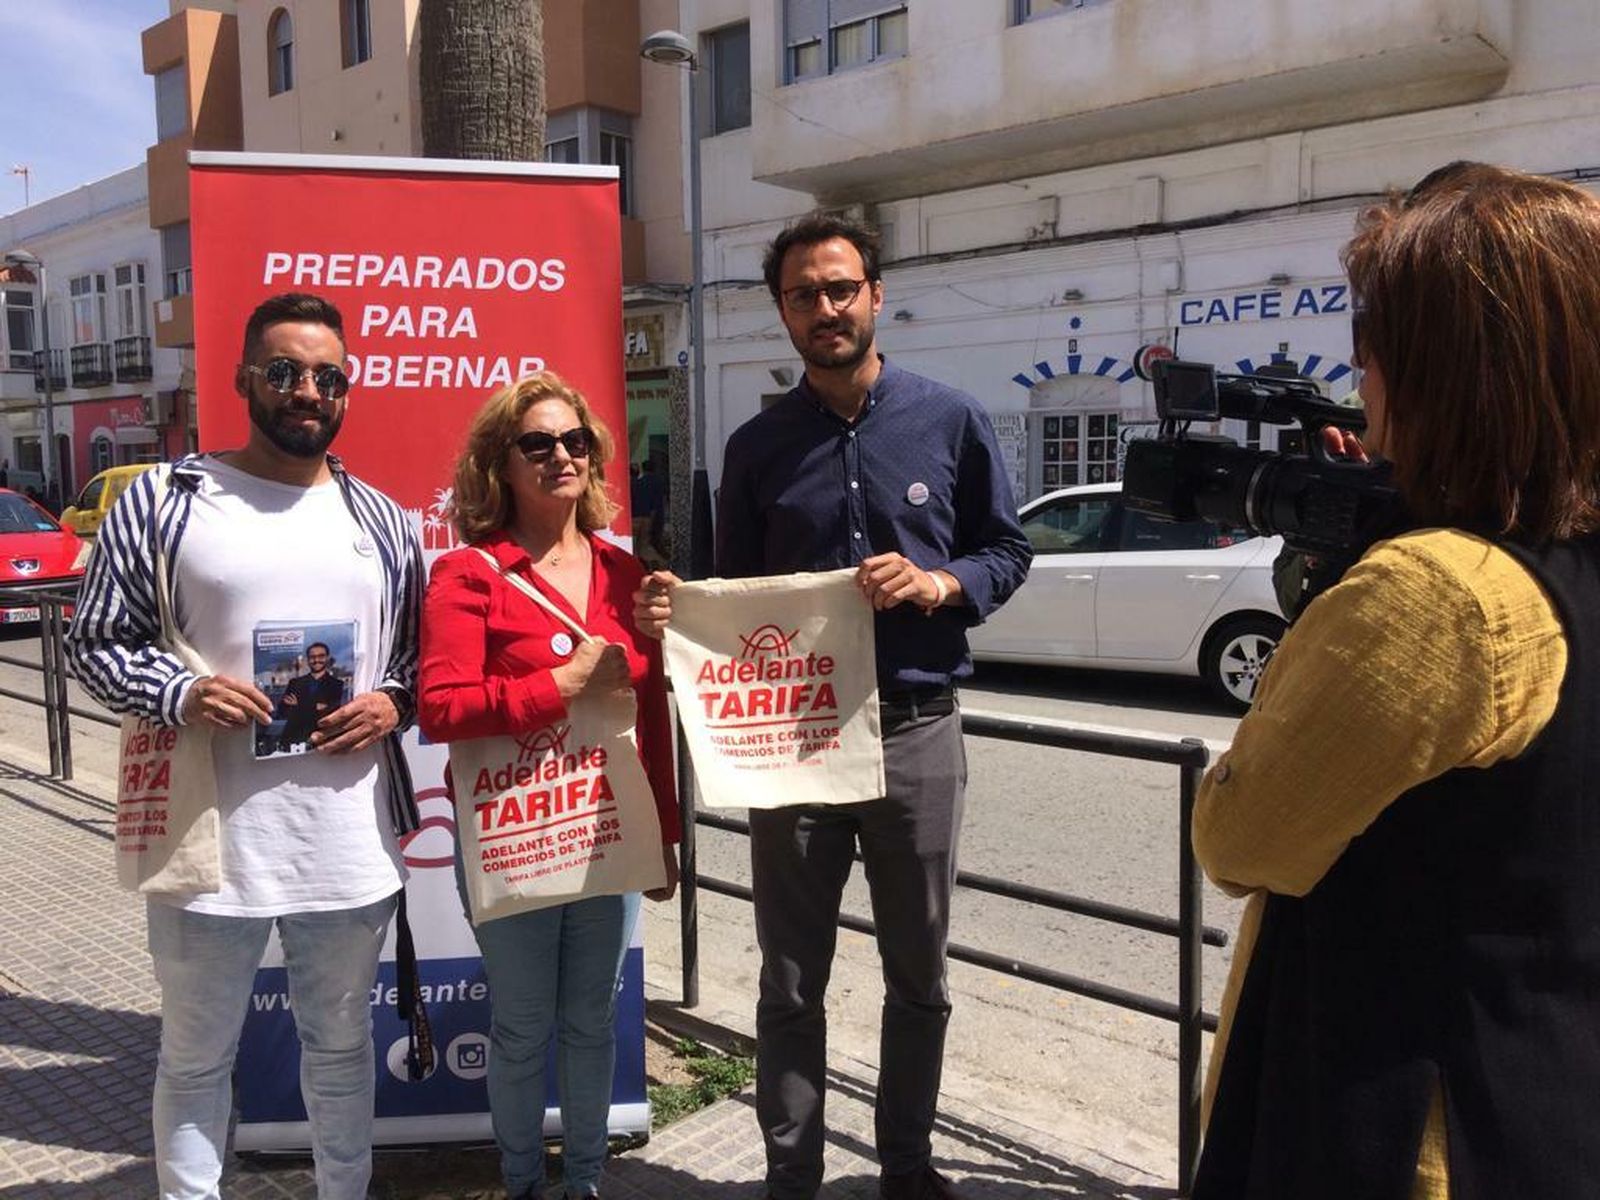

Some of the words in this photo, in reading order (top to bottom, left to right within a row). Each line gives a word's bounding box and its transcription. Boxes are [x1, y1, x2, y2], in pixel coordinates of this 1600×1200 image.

[263, 252, 566, 292] PREPARADOS
[360, 304, 478, 338] PARA
[1181, 288, 1282, 325] CAFÉ
[1293, 285, 1348, 316] AZ
[346, 354, 546, 388] OBERNAR
[695, 652, 835, 685] Adelante
[698, 682, 838, 720] TARIFA
[715, 747, 775, 757] MERCIOS
[778, 745, 795, 755] DE
[799, 741, 840, 752] TARIFA
[777, 729, 808, 742] CON
[812, 727, 840, 739] LOS
[473, 744, 608, 797] Adelante
[474, 774, 616, 832] TARIFA
[481, 835, 554, 861] ADELANTE
[557, 826, 588, 842] CON
[592, 818, 620, 833] LOS
[483, 849, 556, 873] COMERCIOS
[559, 843, 576, 856] DE
[578, 832, 622, 850] TARIFA
